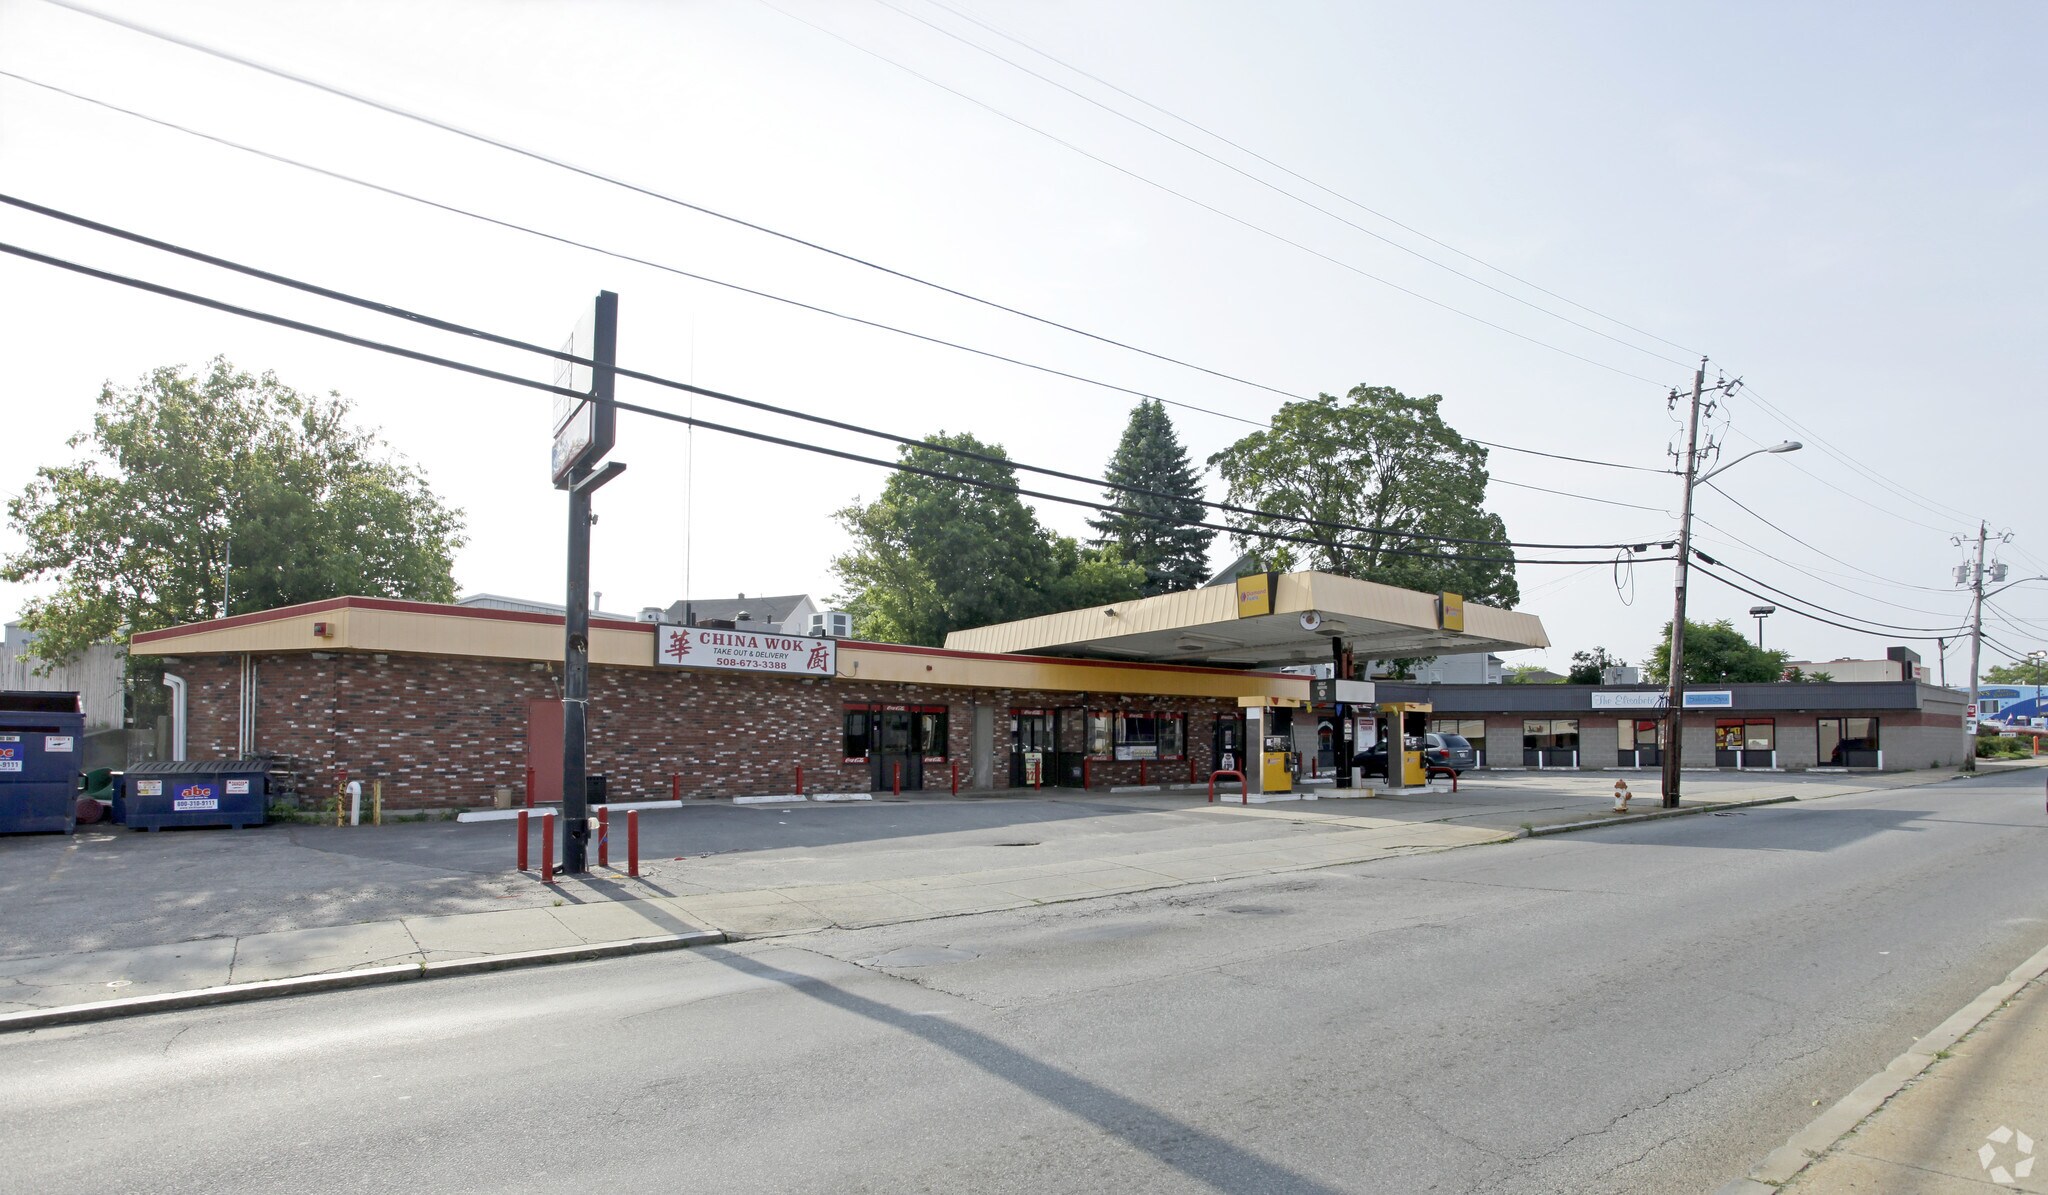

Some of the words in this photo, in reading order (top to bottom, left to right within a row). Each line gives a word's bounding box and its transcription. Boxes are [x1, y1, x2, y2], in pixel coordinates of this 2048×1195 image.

[699, 632, 758, 649] CHINA
[765, 637, 804, 652] WOK
[733, 649, 748, 657] OUT
[755, 651, 789, 660] DELIVERY
[716, 658, 787, 670] 508-673-3388
[182, 785, 211, 797] abc
